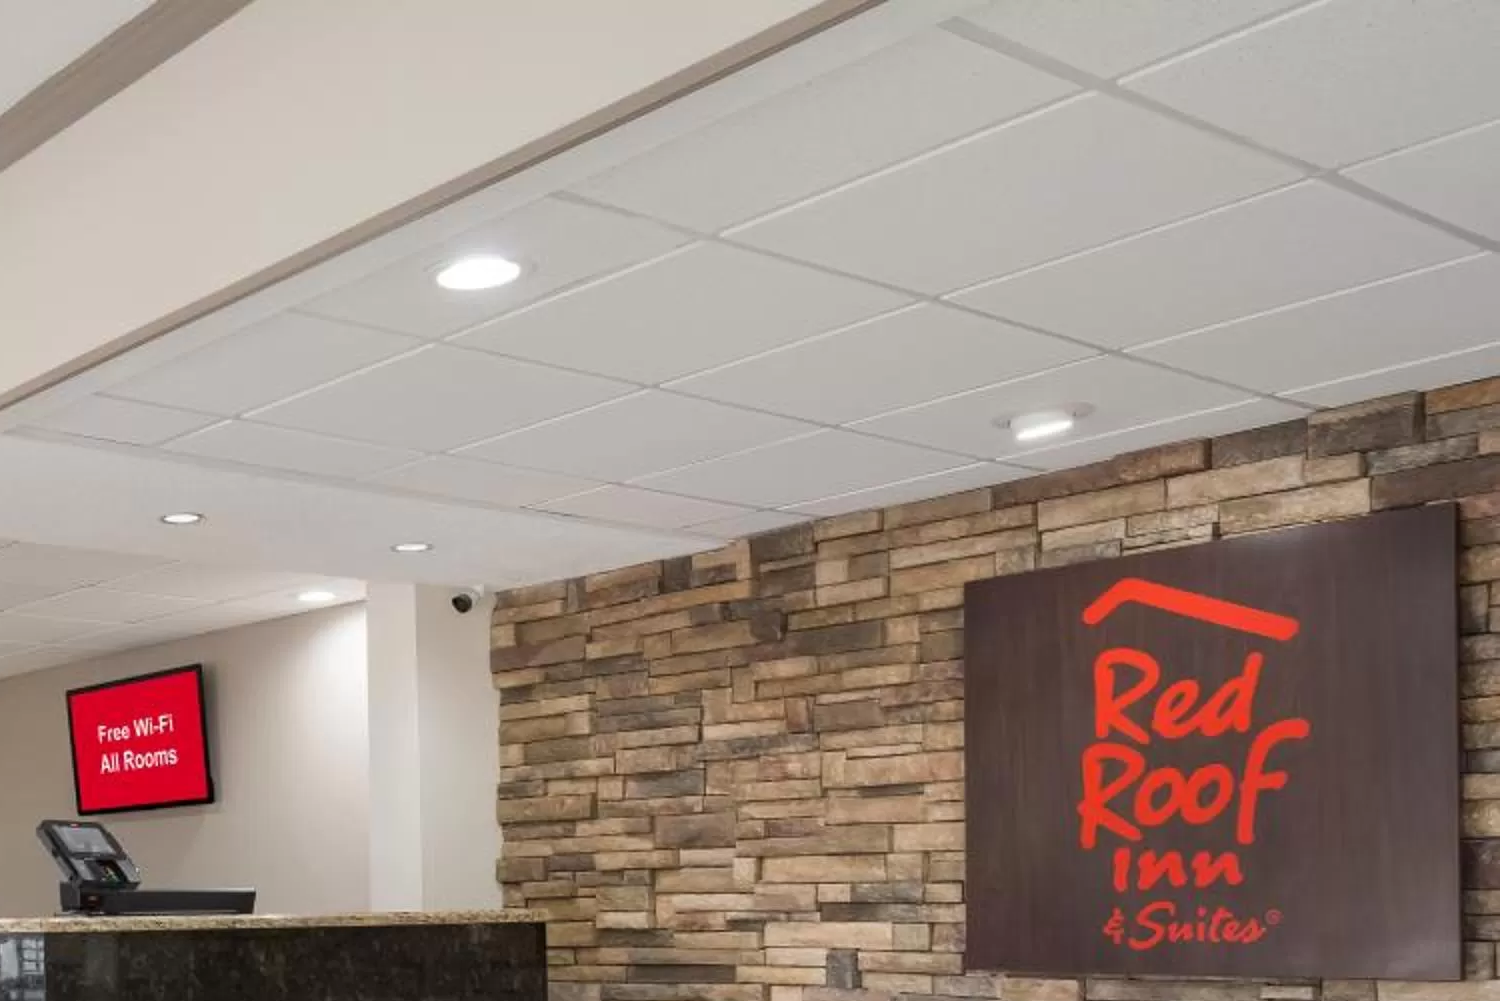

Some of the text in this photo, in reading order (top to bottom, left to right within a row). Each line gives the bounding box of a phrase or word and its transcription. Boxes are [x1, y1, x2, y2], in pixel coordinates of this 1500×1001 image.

[1094, 647, 1264, 744] Red
[97, 714, 174, 743] Free Wi-Fi
[100, 748, 179, 774] All Rooms
[1077, 719, 1310, 849] Roof
[1103, 907, 1125, 945] &
